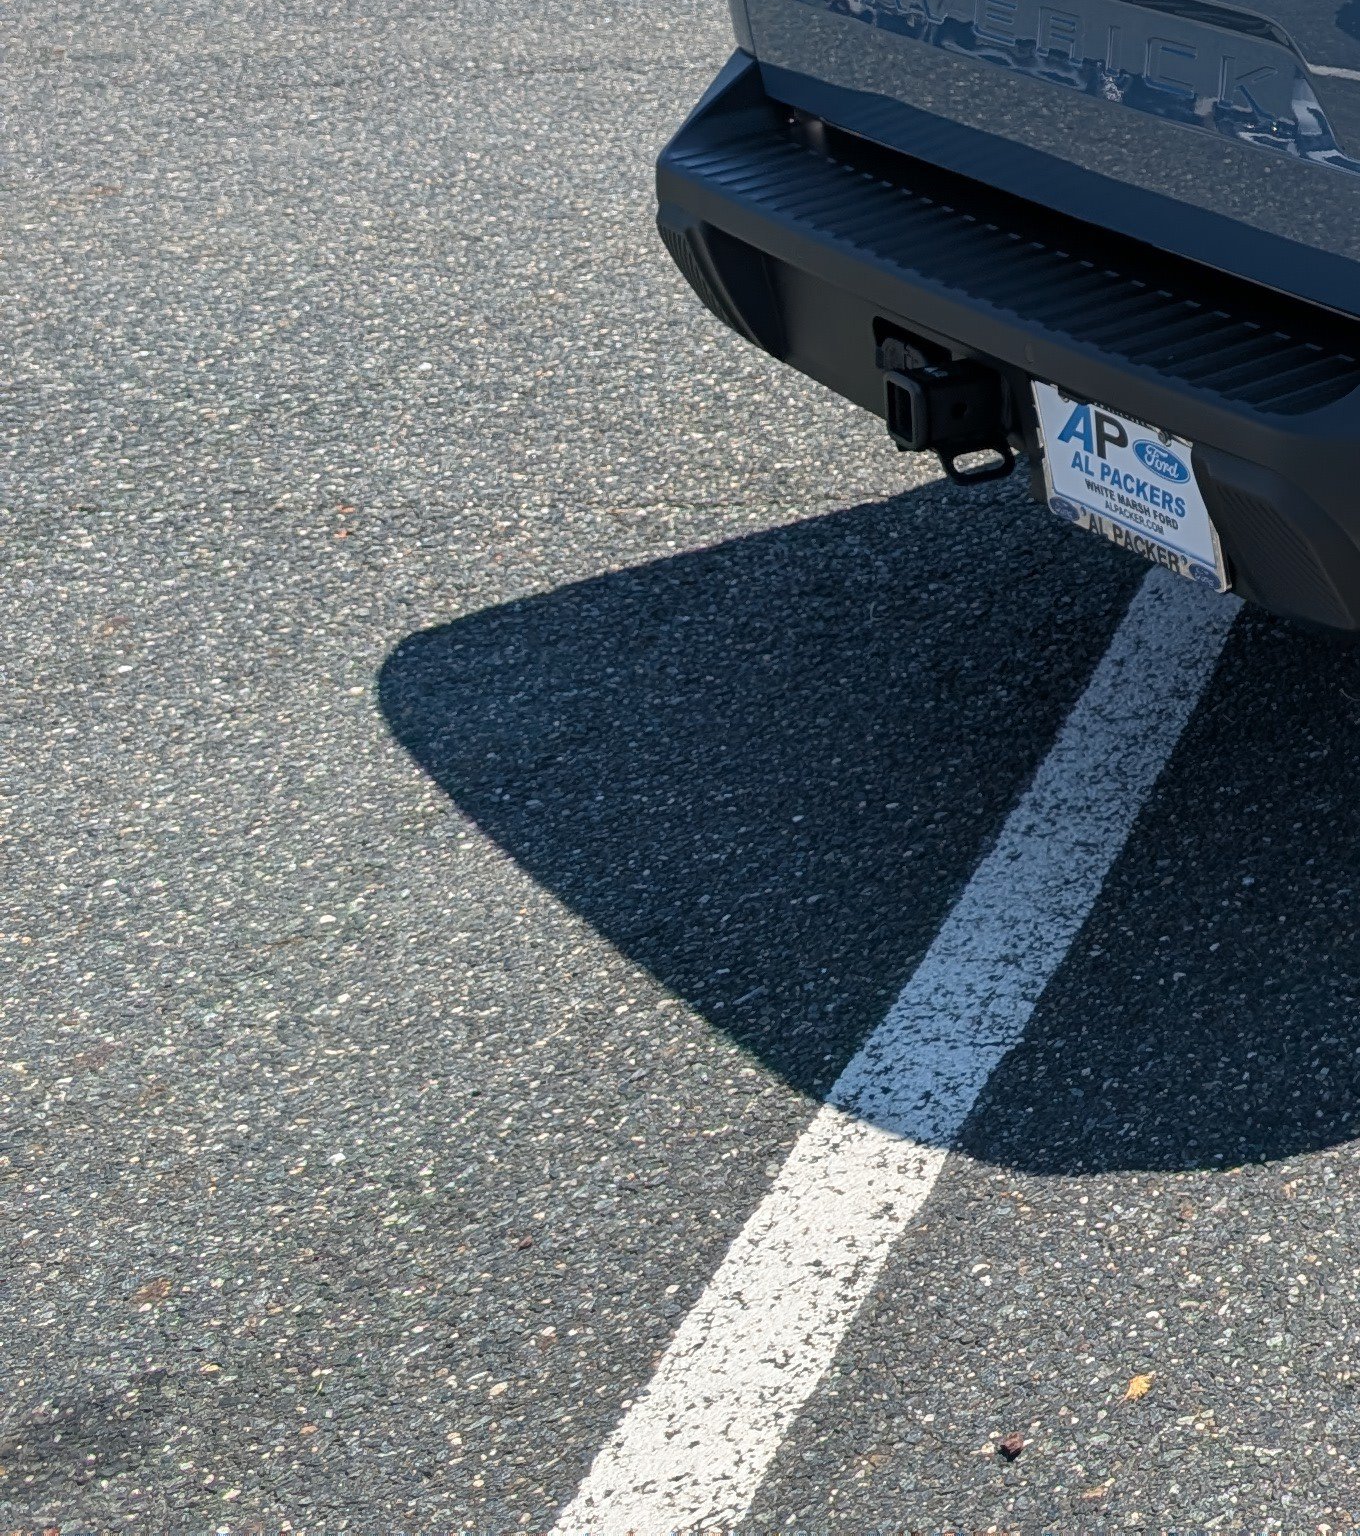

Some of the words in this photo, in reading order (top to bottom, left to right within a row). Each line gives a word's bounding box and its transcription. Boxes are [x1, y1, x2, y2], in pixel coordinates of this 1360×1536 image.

[1057, 402, 1129, 460] AP
[1070, 450, 1095, 477] AL
[1100, 463, 1187, 518] PACKERS
[1144, 444, 1180, 480] Ford
[1084, 478, 1116, 502] WHITE
[1117, 494, 1151, 519] MARSH
[1152, 509, 1179, 531] FORD
